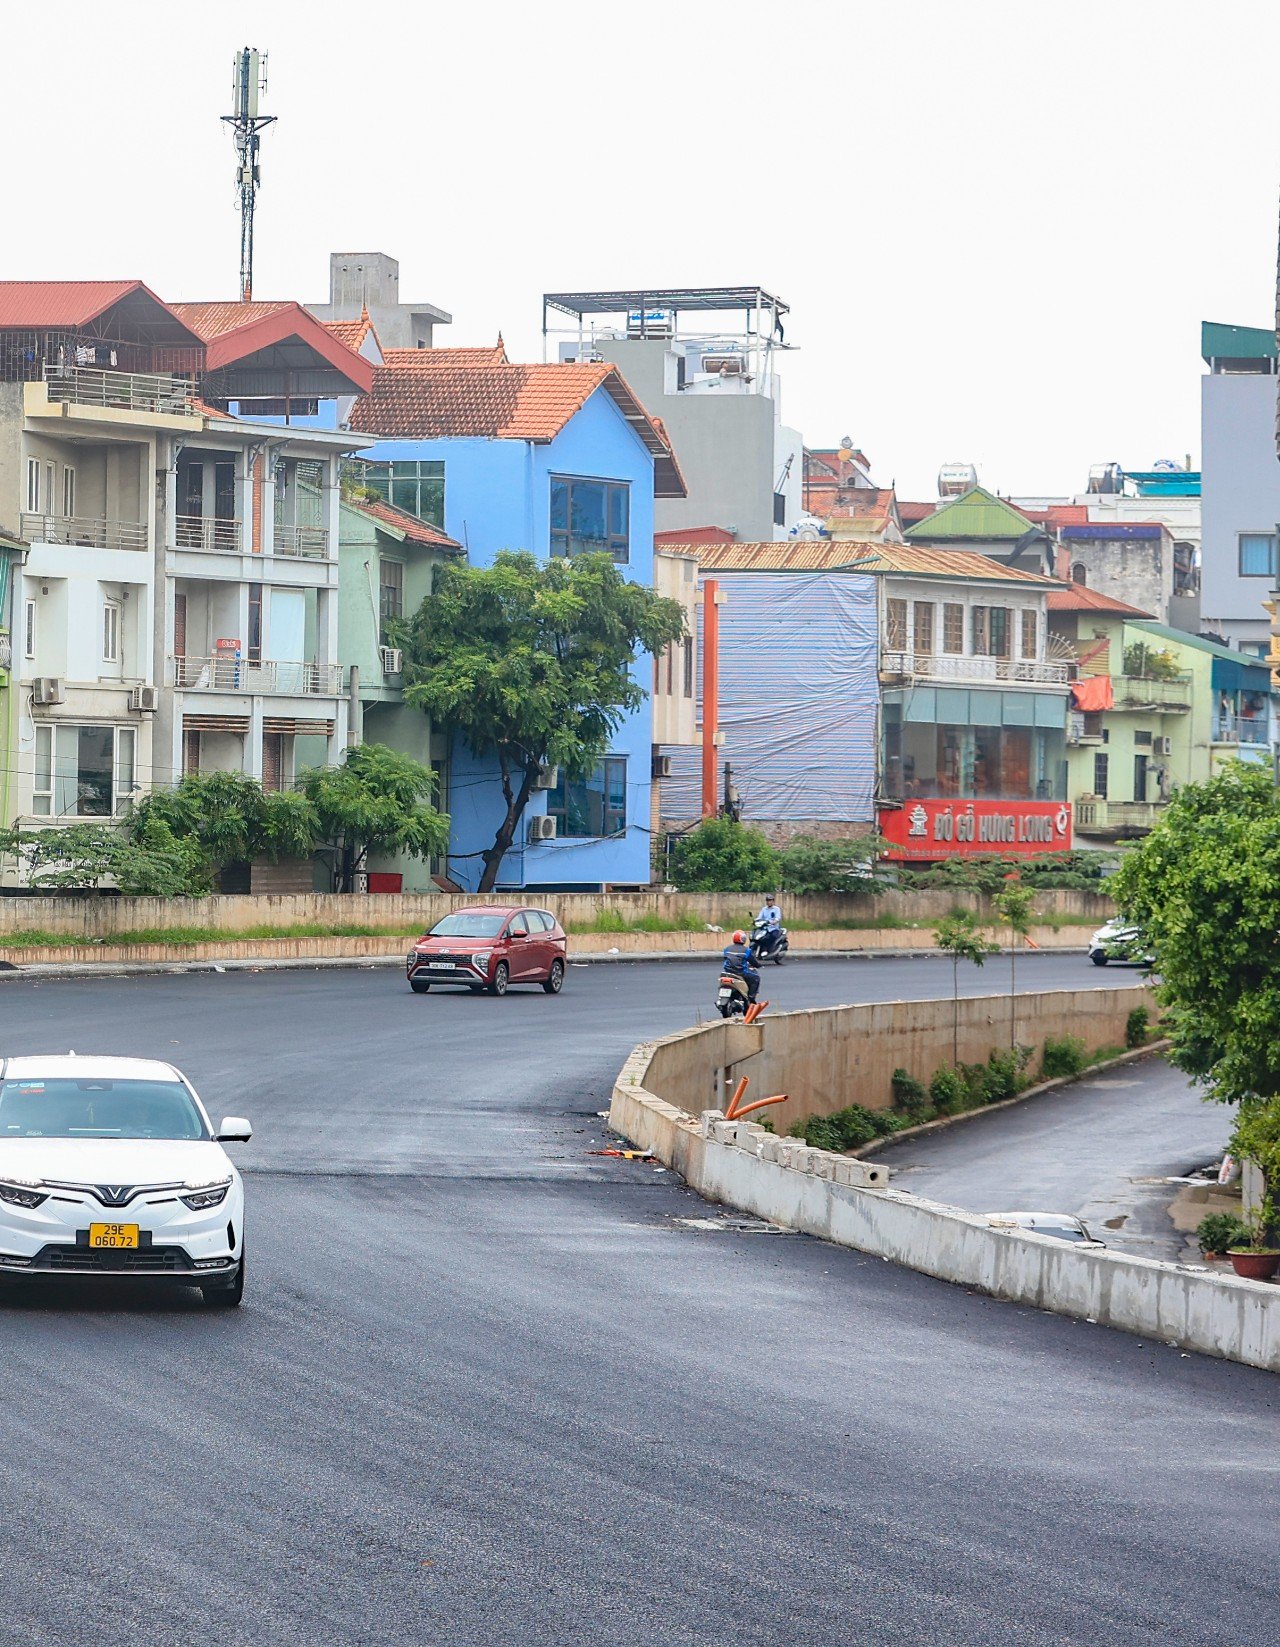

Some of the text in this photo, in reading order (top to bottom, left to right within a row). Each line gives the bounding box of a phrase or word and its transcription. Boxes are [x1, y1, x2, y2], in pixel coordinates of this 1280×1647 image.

[1018, 815, 1053, 842] LONG
[103, 1225, 124, 1236] 29E
[95, 1236, 133, 1247] 060.72
